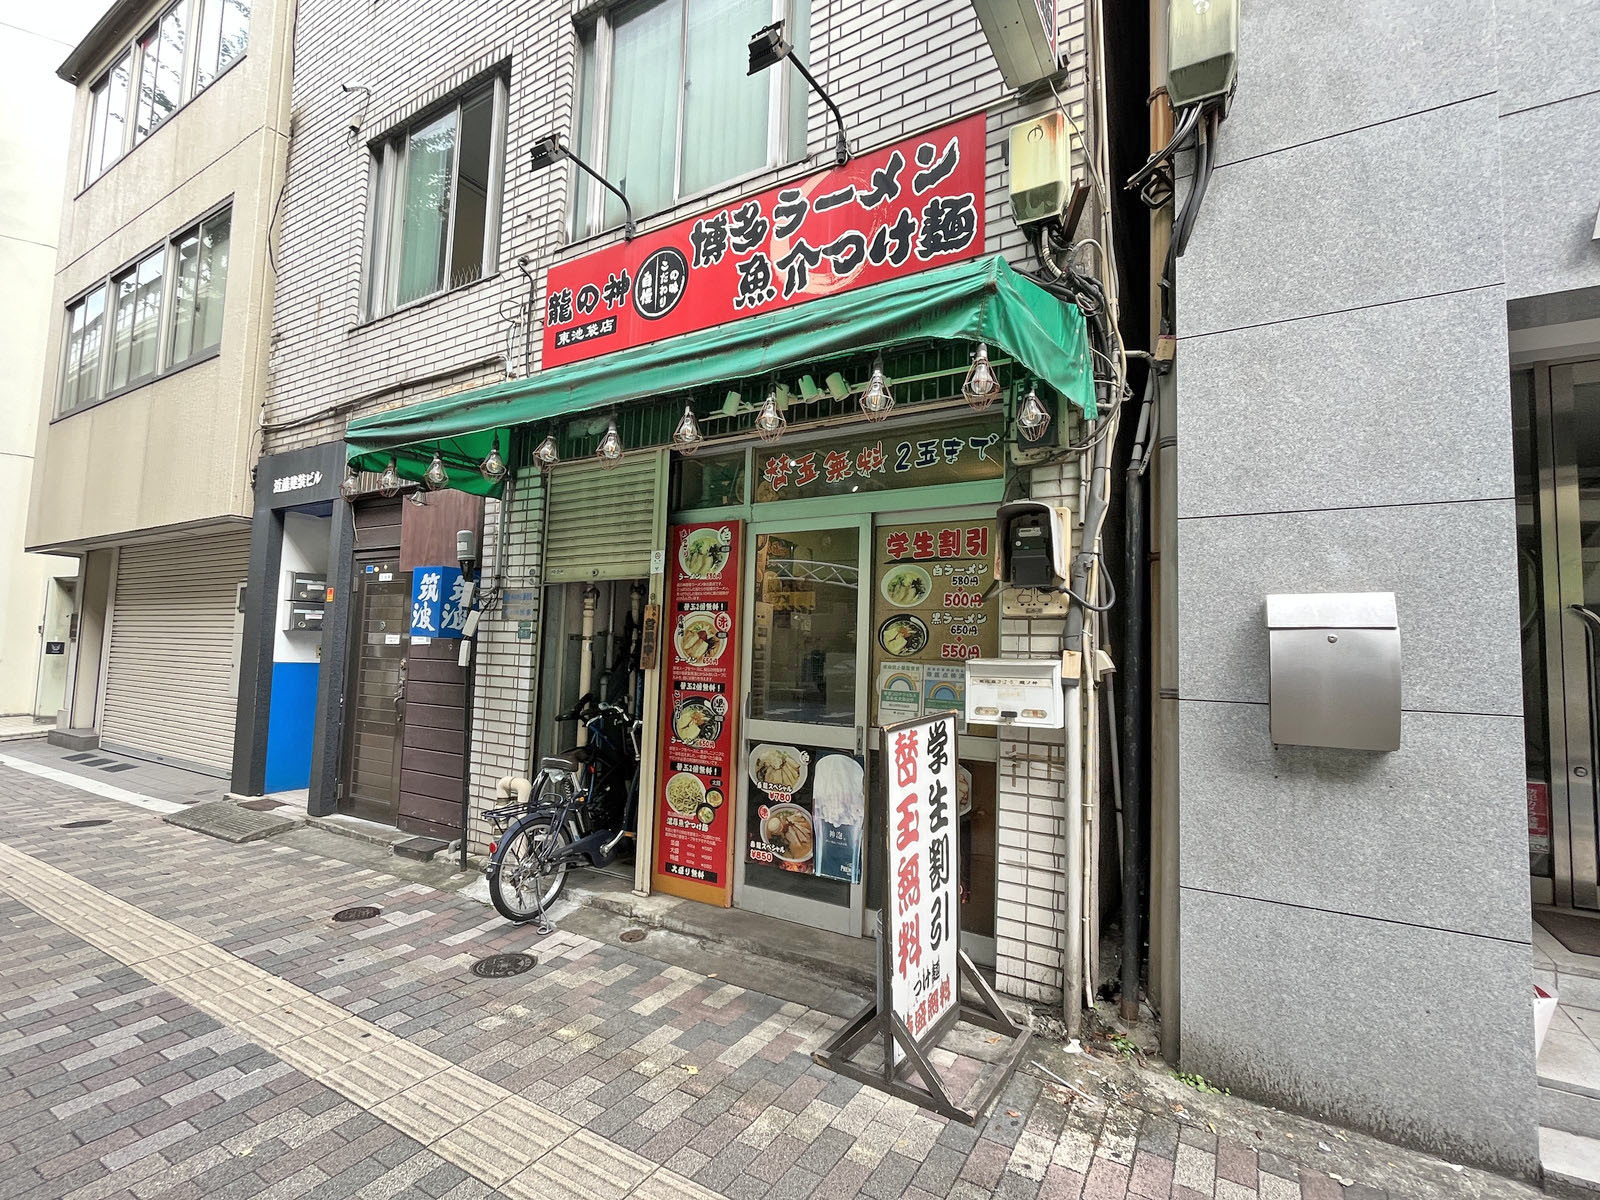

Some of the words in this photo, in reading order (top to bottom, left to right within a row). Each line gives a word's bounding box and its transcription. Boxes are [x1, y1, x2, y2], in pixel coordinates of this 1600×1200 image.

[690, 136, 960, 268] 博多ラーメン
[733, 193, 978, 310] 魚介つけ麺
[547, 268, 632, 327] 龍の神
[660, 260, 669, 308] こだわり
[557, 319, 614, 345] 東池袋店
[763, 441, 889, 491] 替玉無料
[894, 433, 1000, 473] 2玉まで
[886, 527, 988, 559] 学生割引
[932, 564, 988, 576] 白ラーメン
[951, 576, 979, 586] 580円
[412, 573, 440, 631] 筑波
[943, 593, 984, 608] 500円
[931, 612, 987, 624] 黒ラーメン
[950, 625, 978, 635] 650円
[942, 644, 981, 659] 550円
[768, 792, 792, 803] ¥780
[927, 720, 949, 951] 学生割引
[750, 849, 773, 863] ¥850
[895, 730, 922, 980] 替玉無料
[913, 955, 940, 996] つけ麺
